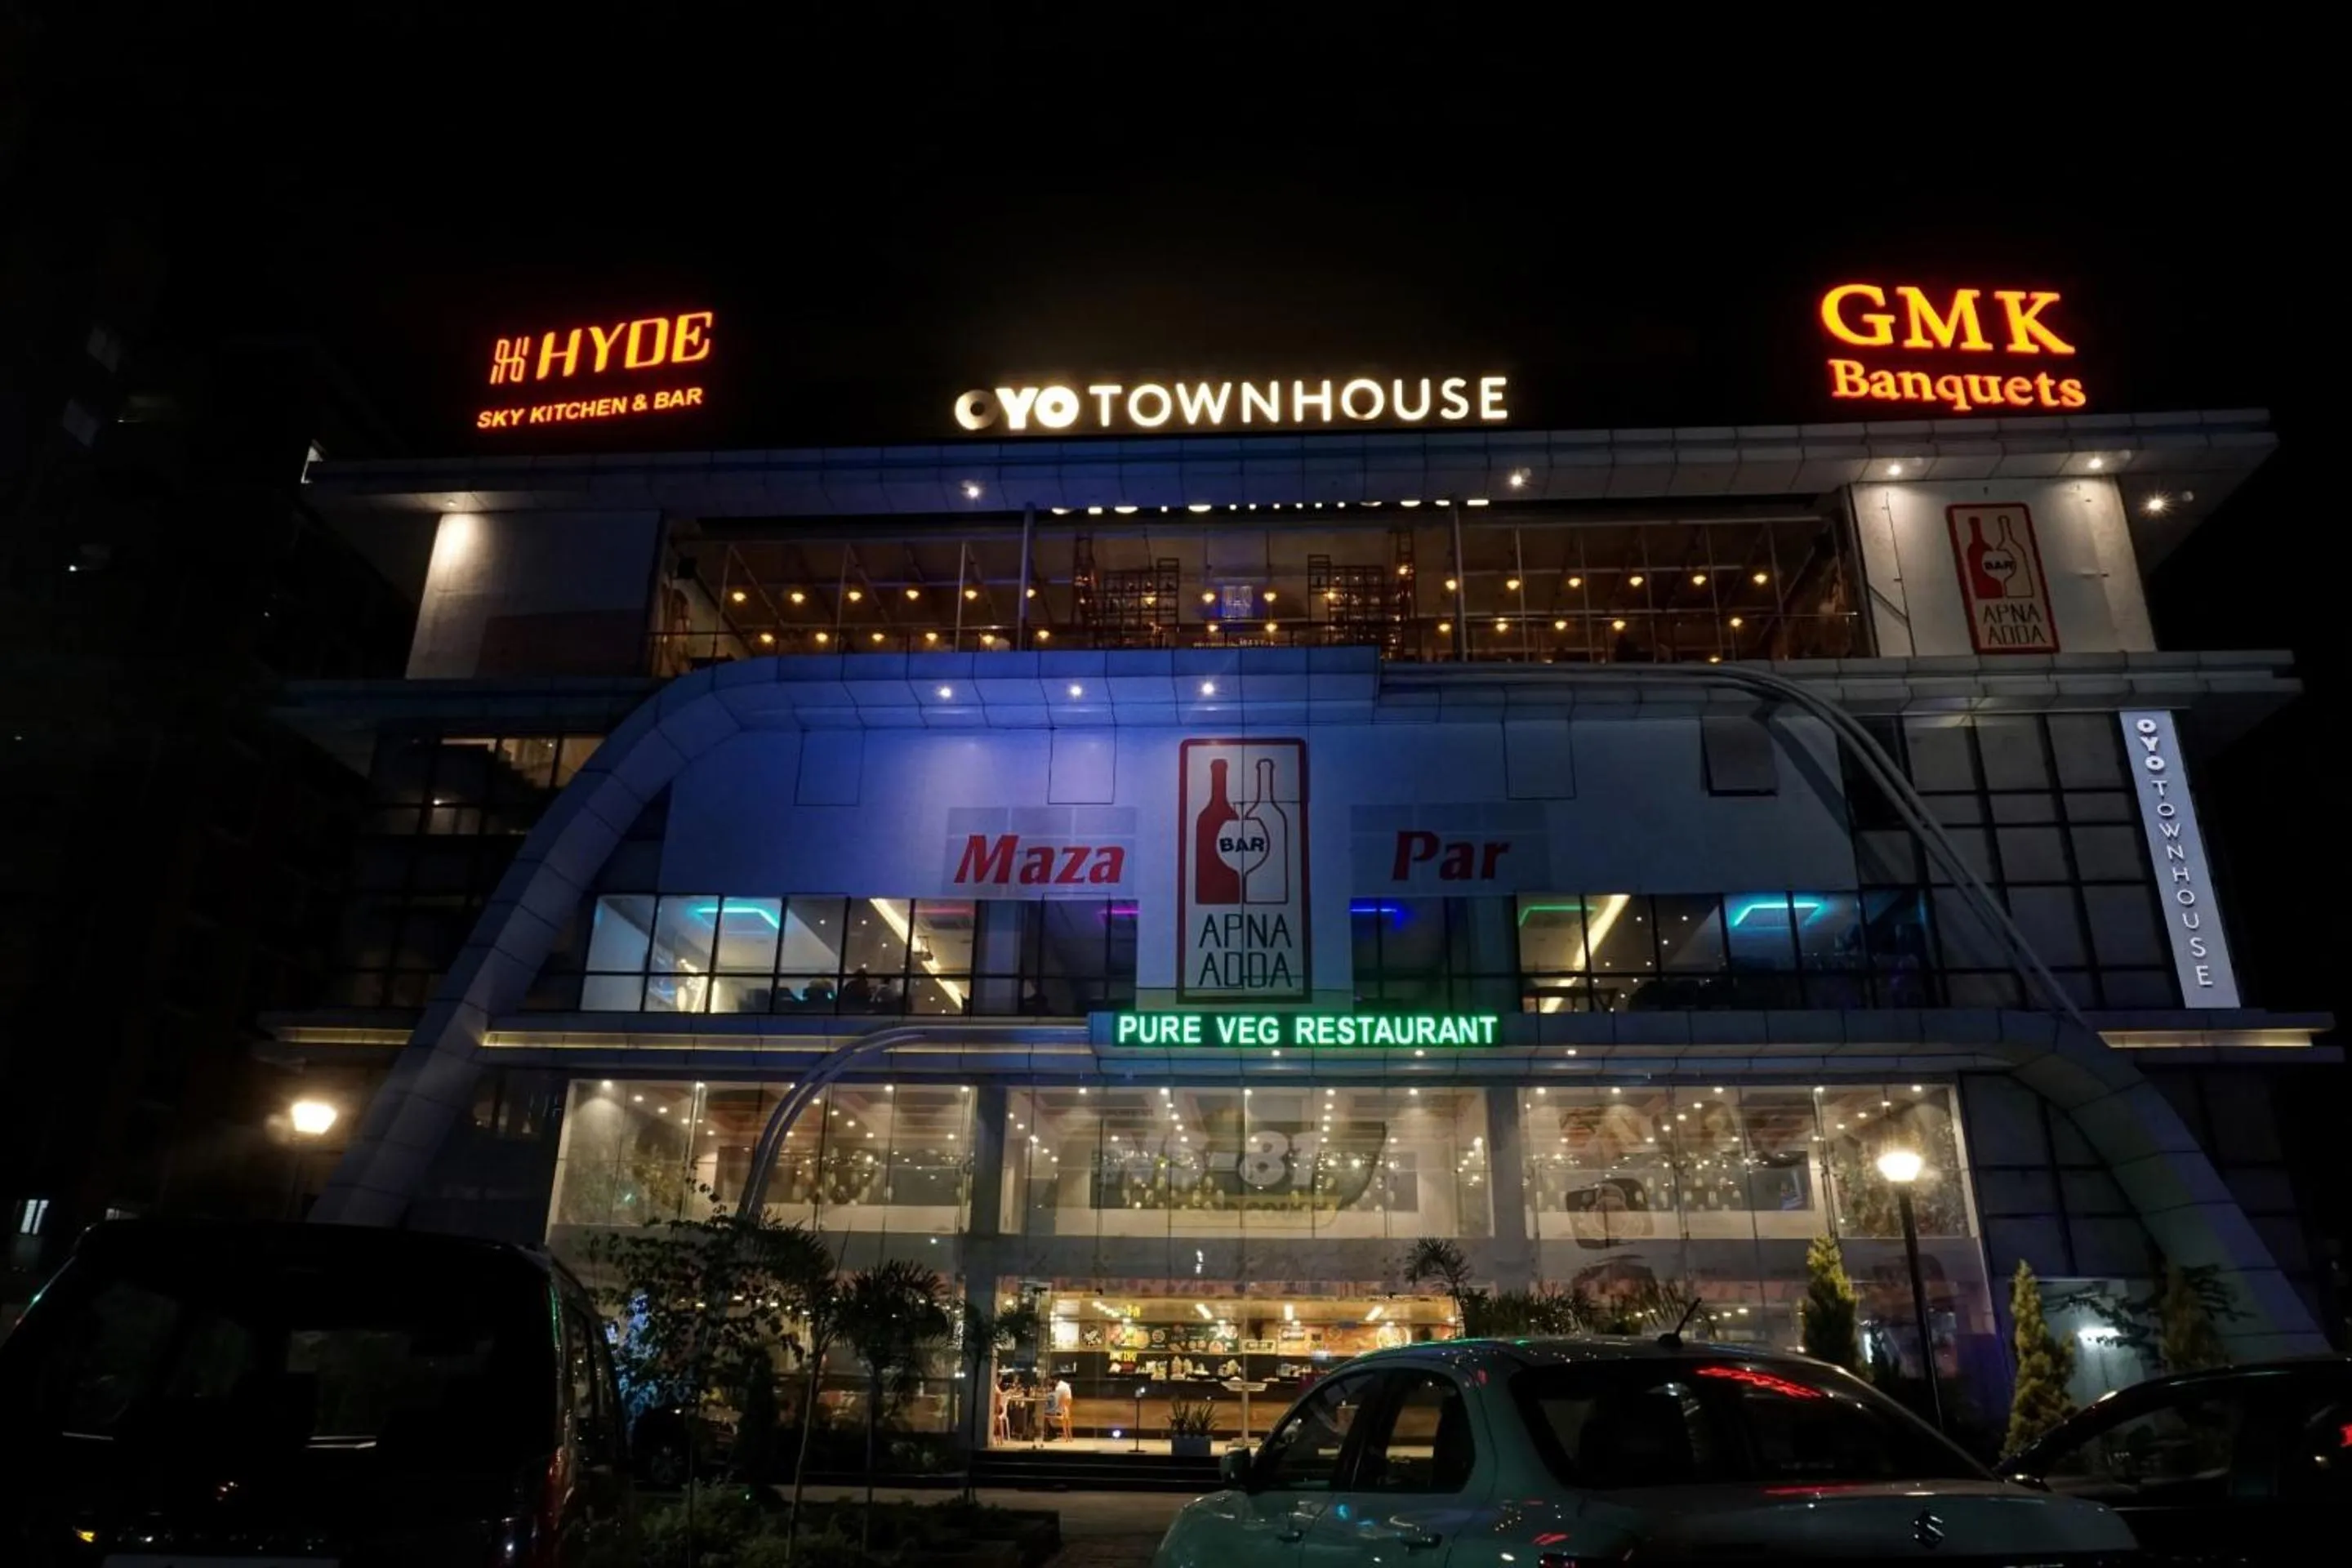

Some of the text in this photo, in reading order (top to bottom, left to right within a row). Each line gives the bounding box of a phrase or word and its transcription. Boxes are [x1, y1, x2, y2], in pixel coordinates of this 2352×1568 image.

[1821, 283, 2076, 354] GMK
[535, 310, 713, 381] HYDE
[476, 386, 703, 428] SKY KITCHEN & BAR
[954, 376, 1508, 431] OYO TOWNHOUSE
[1828, 359, 2087, 411] Banquets
[1984, 560, 2014, 571] BAR
[1983, 603, 2042, 625] APNA
[954, 830, 1511, 885] Maza Par
[1219, 836, 1266, 853] BAR
[2136, 718, 2212, 986] OYO TOWNHOUSE
[1198, 913, 1293, 949] APNA
[1118, 1016, 1499, 1045] PURE VEG RESTAURANT
